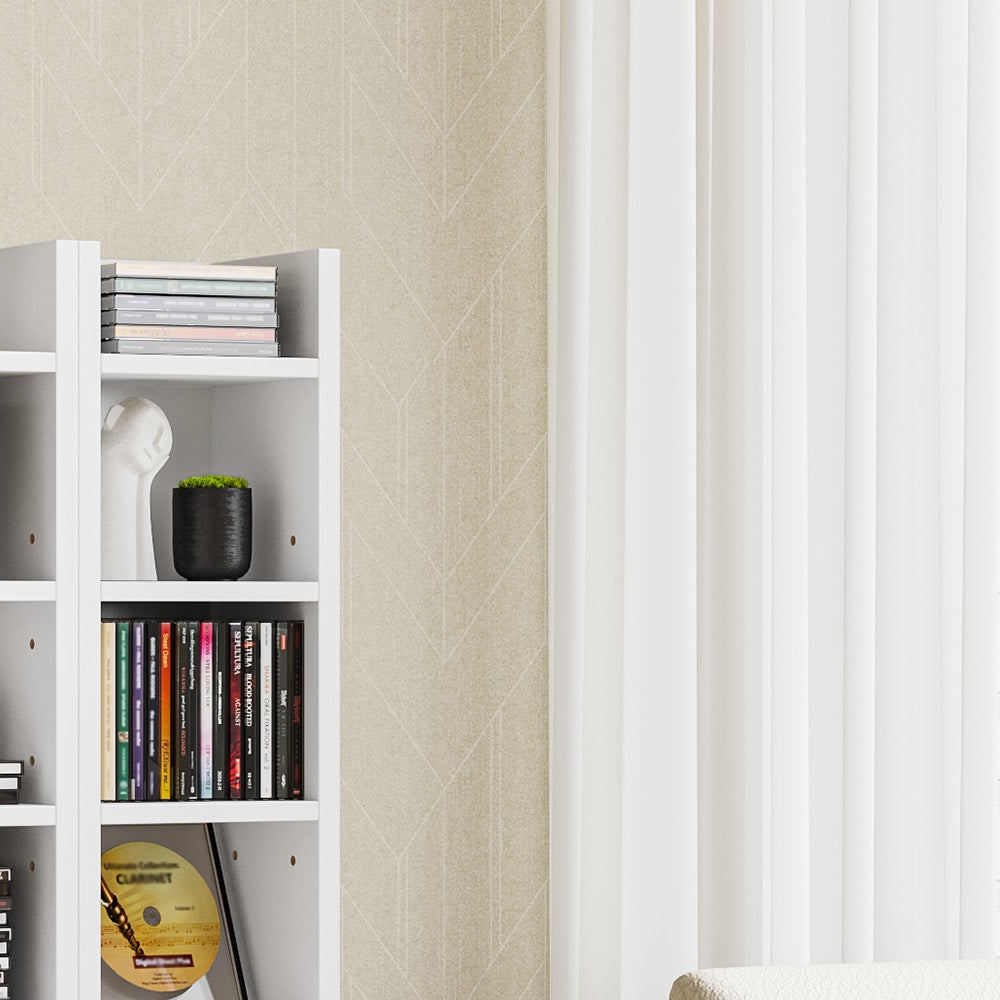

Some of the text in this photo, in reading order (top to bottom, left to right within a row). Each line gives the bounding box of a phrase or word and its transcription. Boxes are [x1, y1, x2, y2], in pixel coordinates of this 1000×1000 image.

[244, 626, 253, 668] SEPULTURA
[233, 631, 242, 726] SEPULTURA AGAINST
[263, 664, 271, 694] SHAKIRA
[263, 698, 271, 716] ORAL
[263, 718, 271, 750] FIXATION
[116, 872, 172, 884] CLARINET
